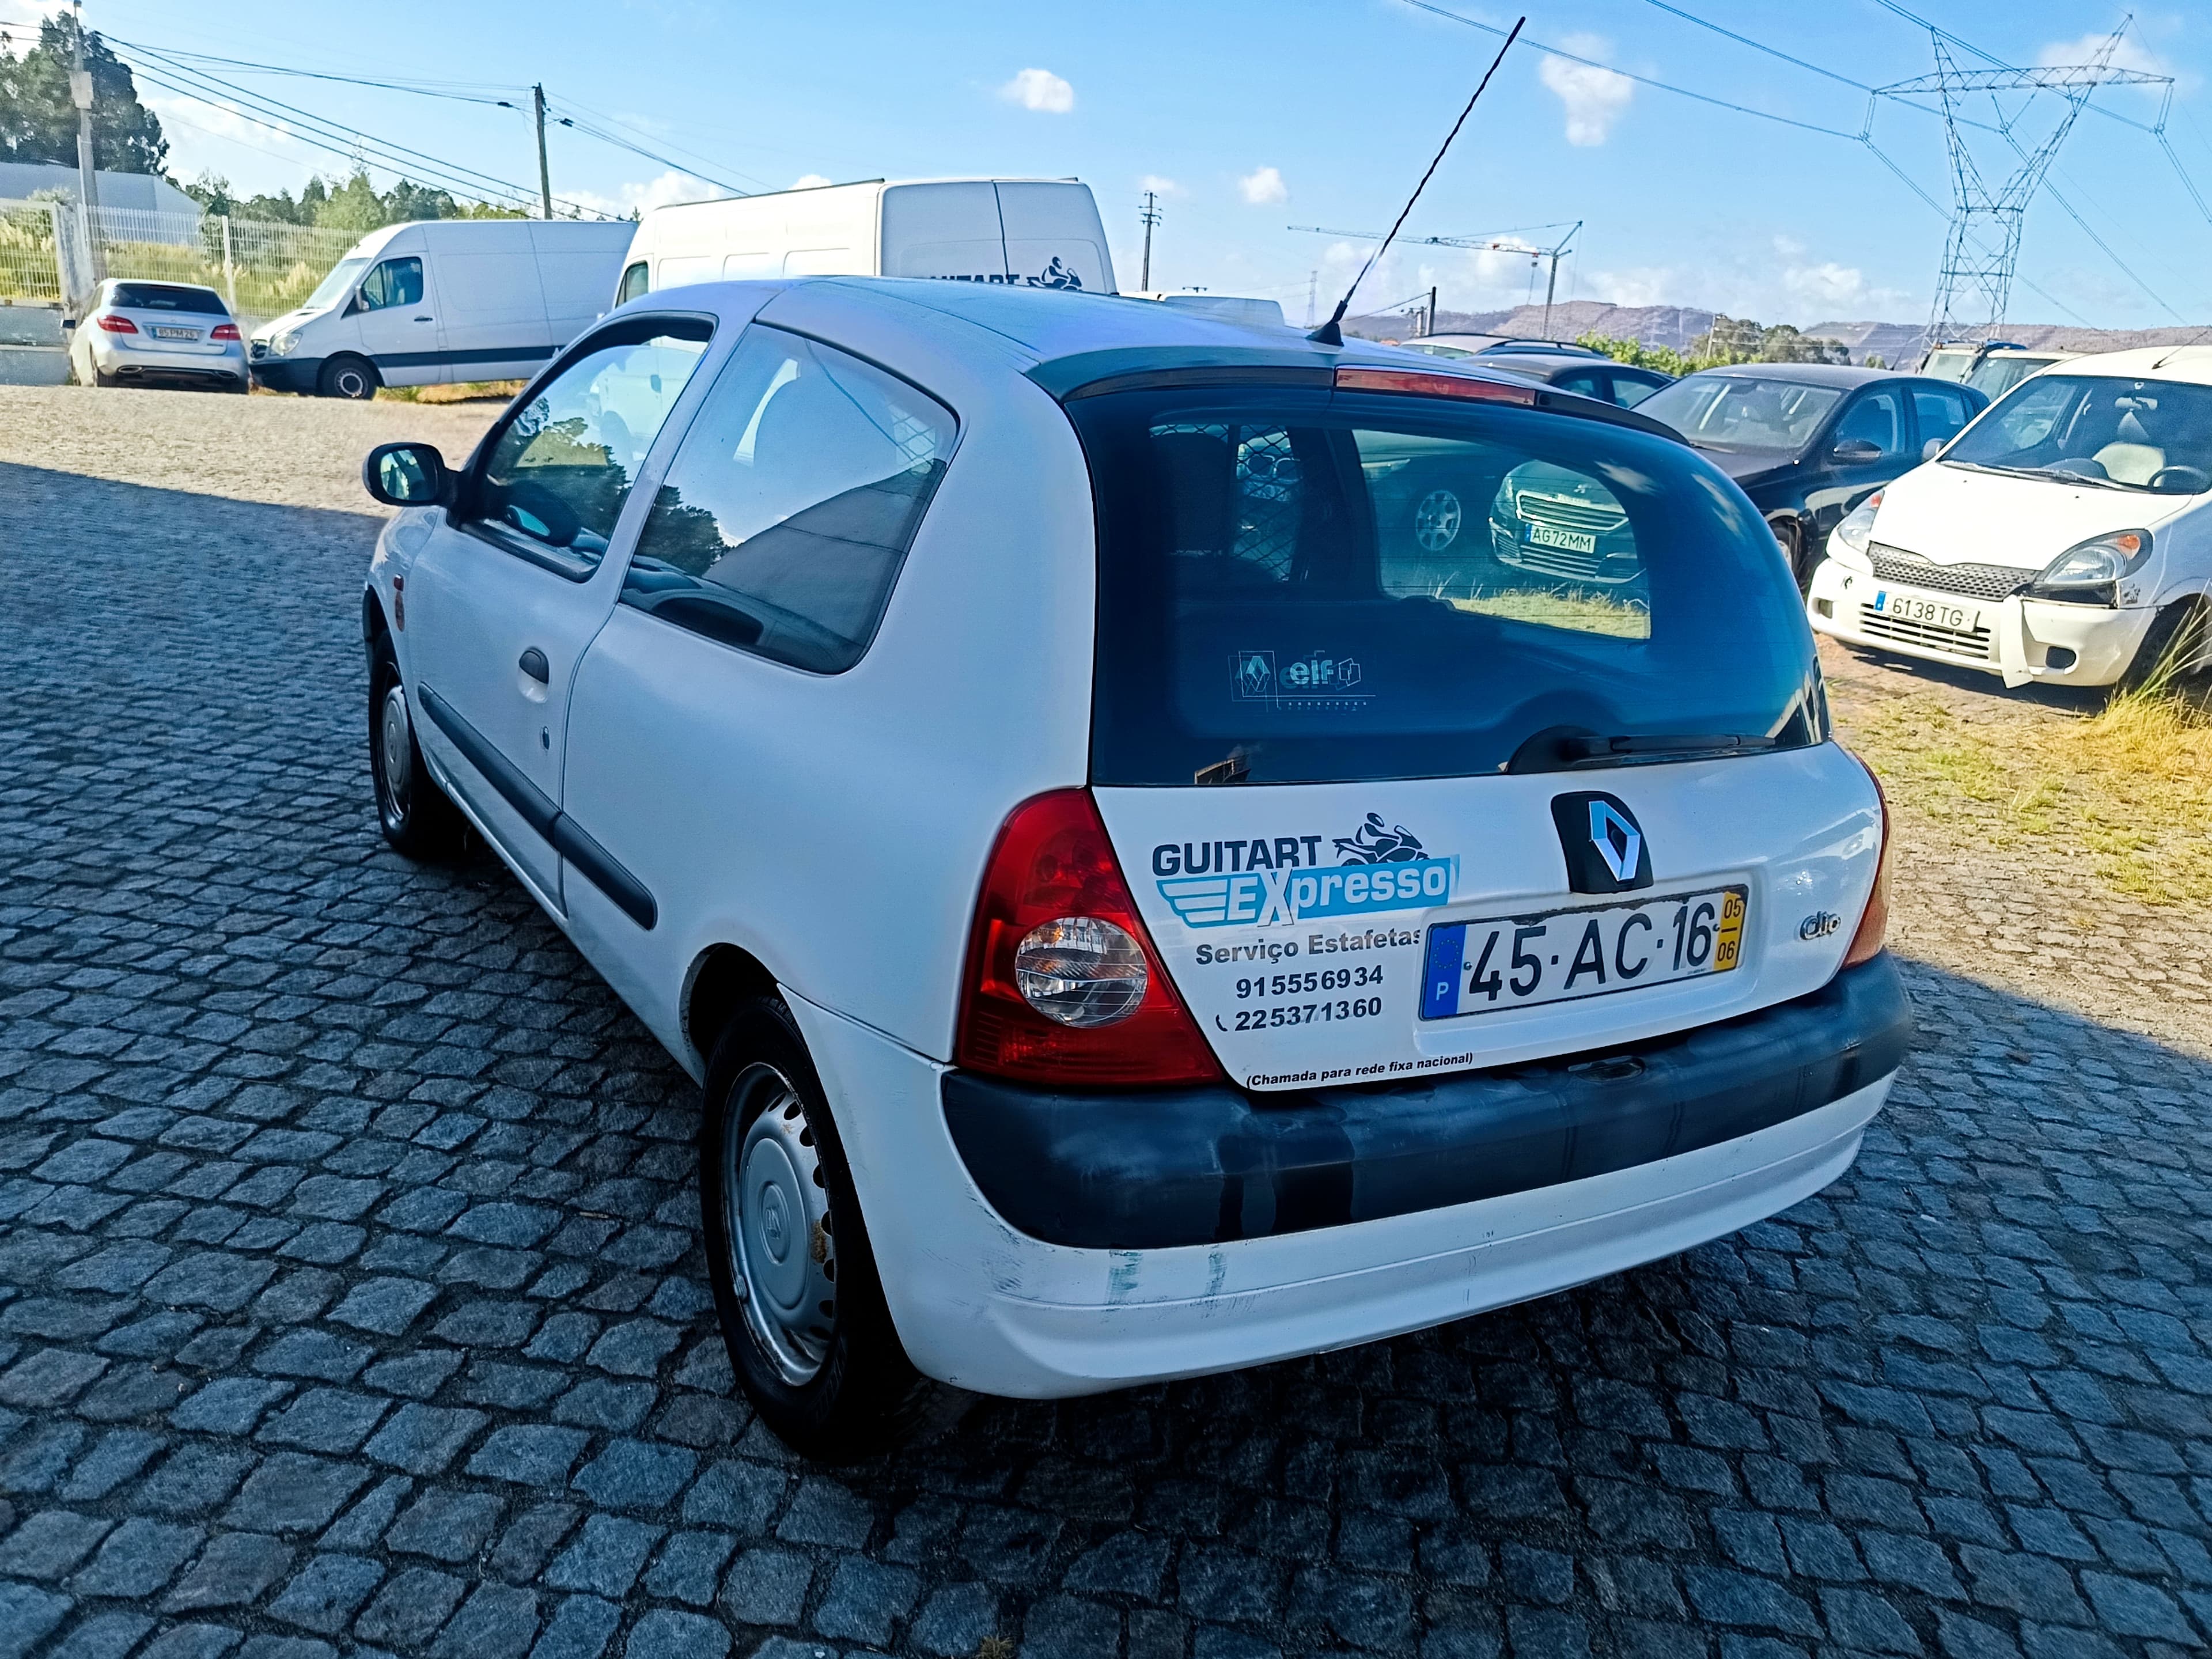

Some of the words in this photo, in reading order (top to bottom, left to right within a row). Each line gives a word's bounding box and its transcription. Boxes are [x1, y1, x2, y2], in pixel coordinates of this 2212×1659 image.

[1533, 528, 1592, 551] AG72MM
[1290, 660, 1334, 685] elf
[1152, 835, 1322, 877] GUITART
[1724, 897, 1741, 920] 05
[1195, 938, 1299, 964] Serviço
[1308, 928, 1421, 955] Estafetas
[1717, 940, 1736, 962] 06
[1236, 965, 1383, 999] 915556934
[1435, 982, 1449, 1001] P
[1234, 997, 1382, 1032] 225371360
[1246, 1070, 1317, 1089] (Chamada
[1320, 1067, 1351, 1082] para
[1355, 1063, 1385, 1076] rede
[1389, 1060, 1413, 1073] fixa
[1416, 1052, 1474, 1069] nacional)
